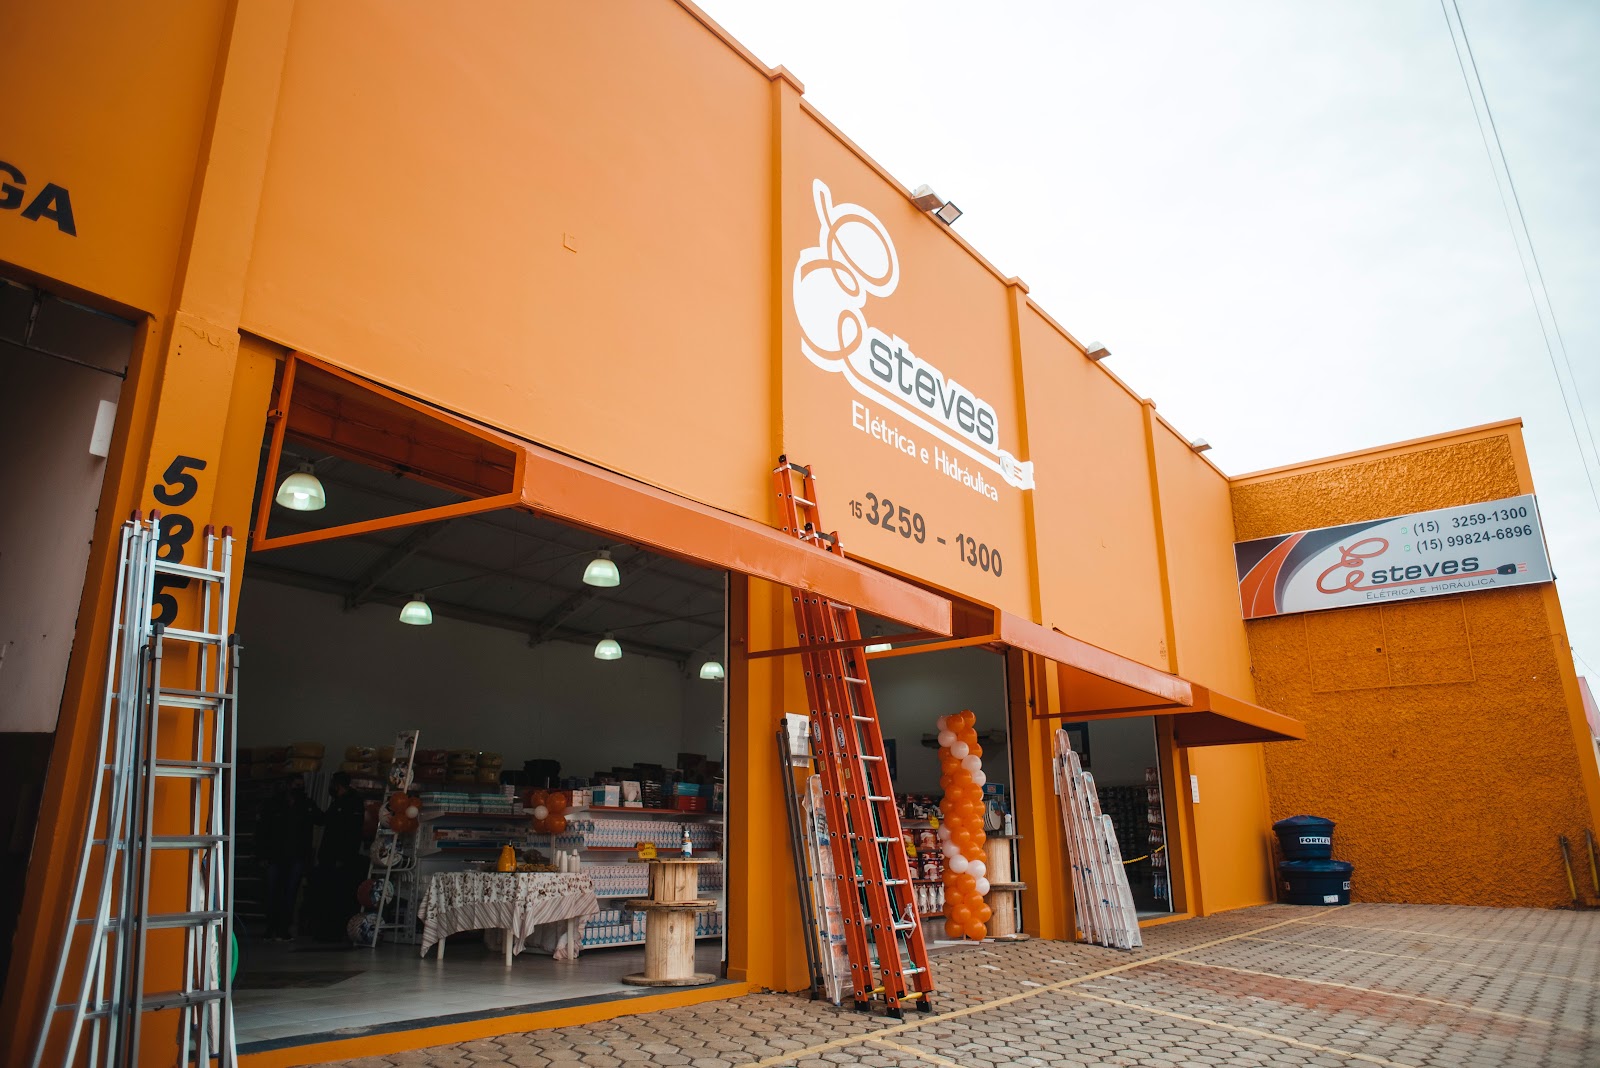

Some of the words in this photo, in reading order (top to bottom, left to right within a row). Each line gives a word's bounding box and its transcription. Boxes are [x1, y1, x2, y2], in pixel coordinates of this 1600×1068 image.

[852, 400, 916, 458] Elétrica
[920, 448, 929, 464] e
[935, 446, 998, 503] Hidráulica
[849, 500, 862, 519] 15
[866, 492, 926, 544] 3259
[956, 533, 1003, 577] 1300
[1413, 520, 1440, 536] (15)
[1452, 506, 1527, 528] 3259-1300
[1416, 538, 1443, 554] (15)
[1447, 524, 1532, 547] 99824-6896
[1316, 537, 1480, 594] Esteves
[1366, 588, 1415, 600] ELÉTRICA
[1431, 577, 1496, 592] HIDRÁULICA
